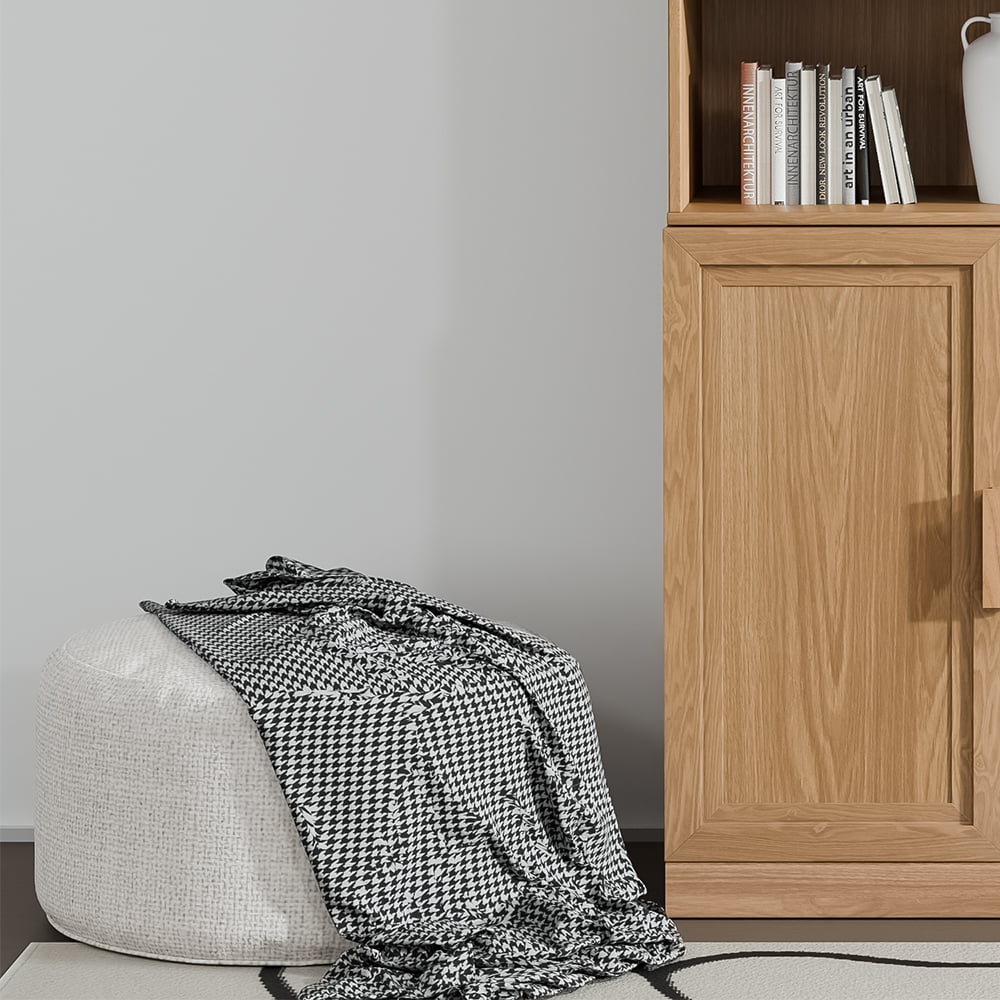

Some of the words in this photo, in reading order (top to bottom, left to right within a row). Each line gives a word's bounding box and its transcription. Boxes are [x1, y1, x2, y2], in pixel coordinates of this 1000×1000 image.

[774, 86, 783, 100] ART
[818, 73, 826, 128] REVOLUTION
[857, 94, 865, 112] FOR
[774, 102, 783, 119] FOR
[842, 86, 854, 127] urban
[786, 71, 799, 186] INNENARCHITEKTUR
[858, 113, 866, 150] SURVIVAL
[742, 83, 755, 200] INNENARCHITEKTUR
[818, 130, 826, 154] LOOK
[844, 131, 854, 148] an
[818, 155, 826, 176] NEW
[842, 151, 854, 165] in
[843, 169, 854, 189] art
